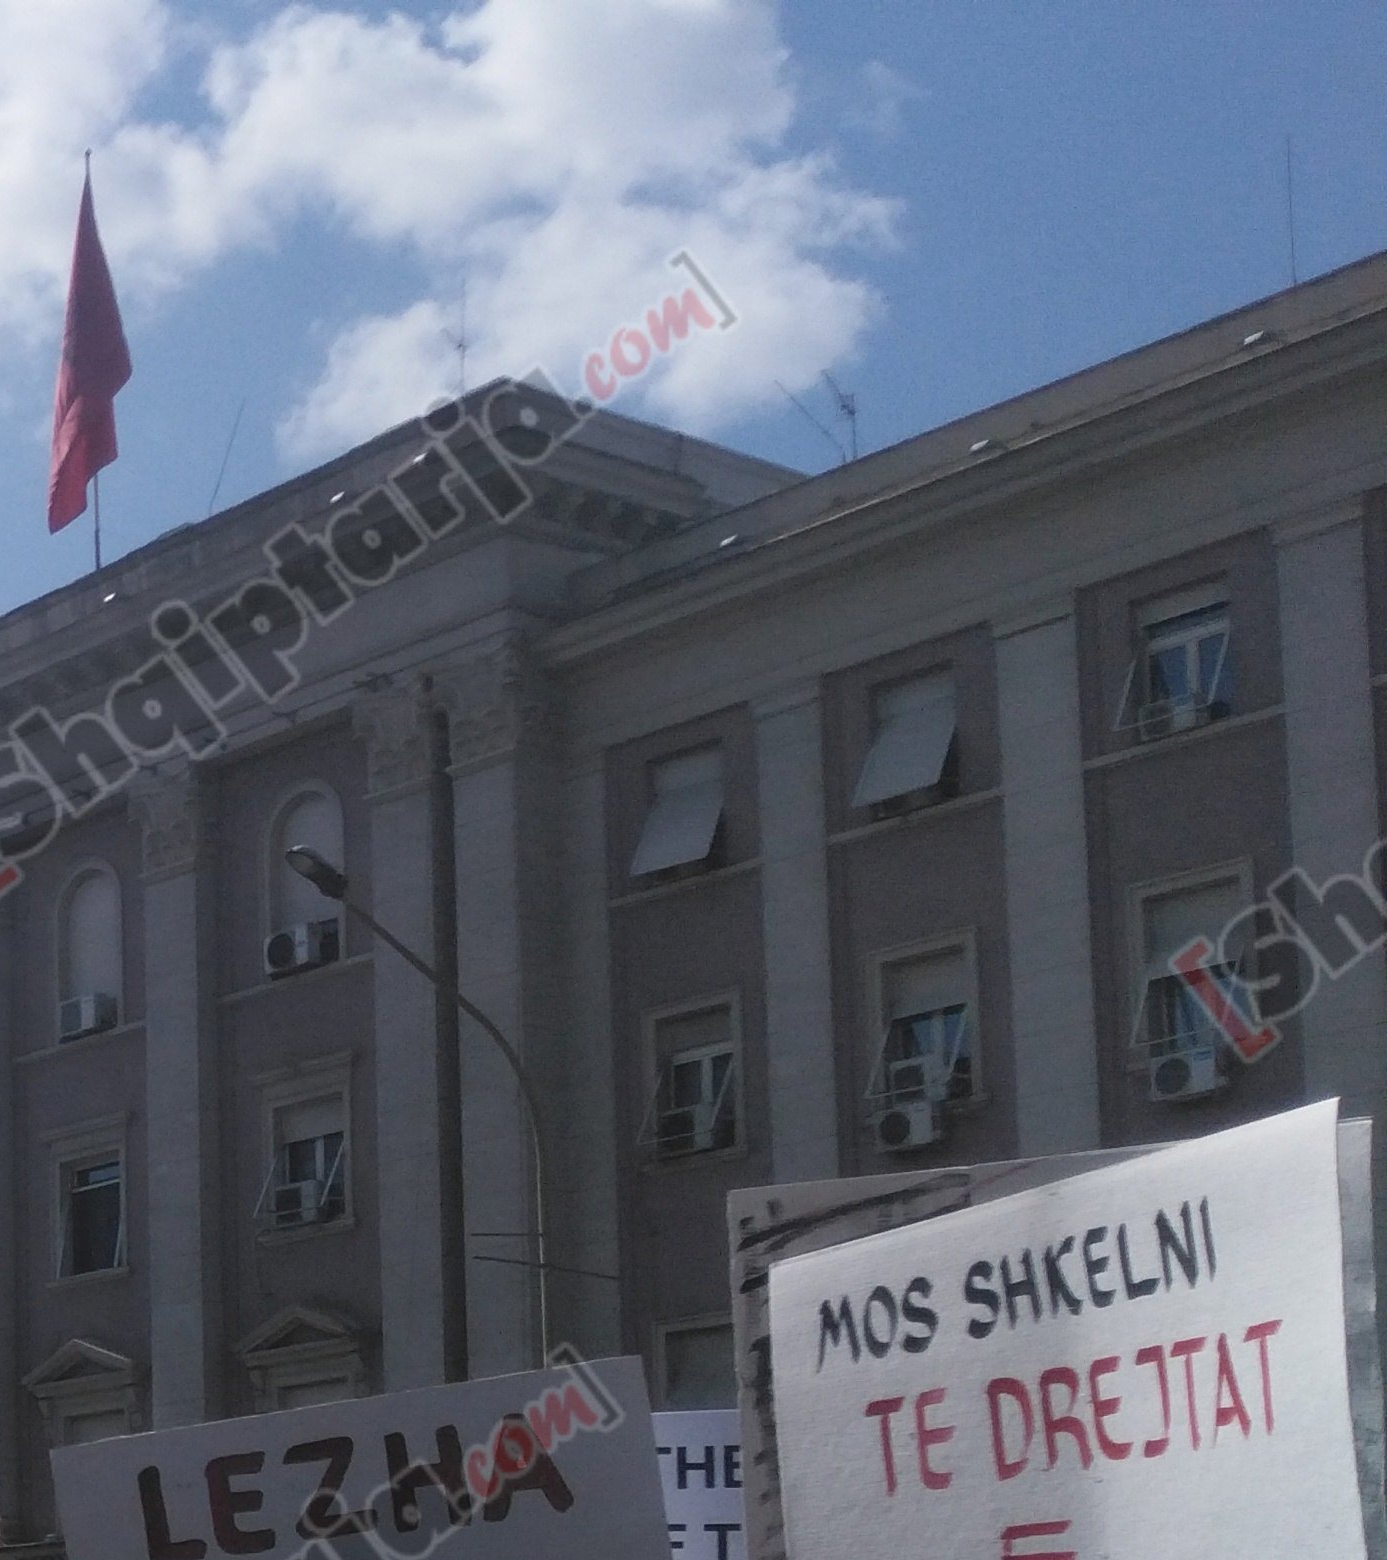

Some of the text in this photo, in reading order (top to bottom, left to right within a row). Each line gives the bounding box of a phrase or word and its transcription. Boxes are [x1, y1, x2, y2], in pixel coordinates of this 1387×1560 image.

[815, 1196, 1220, 1374] MOS SHKELNI
[864, 1318, 1284, 1497] TE DREJTAT
